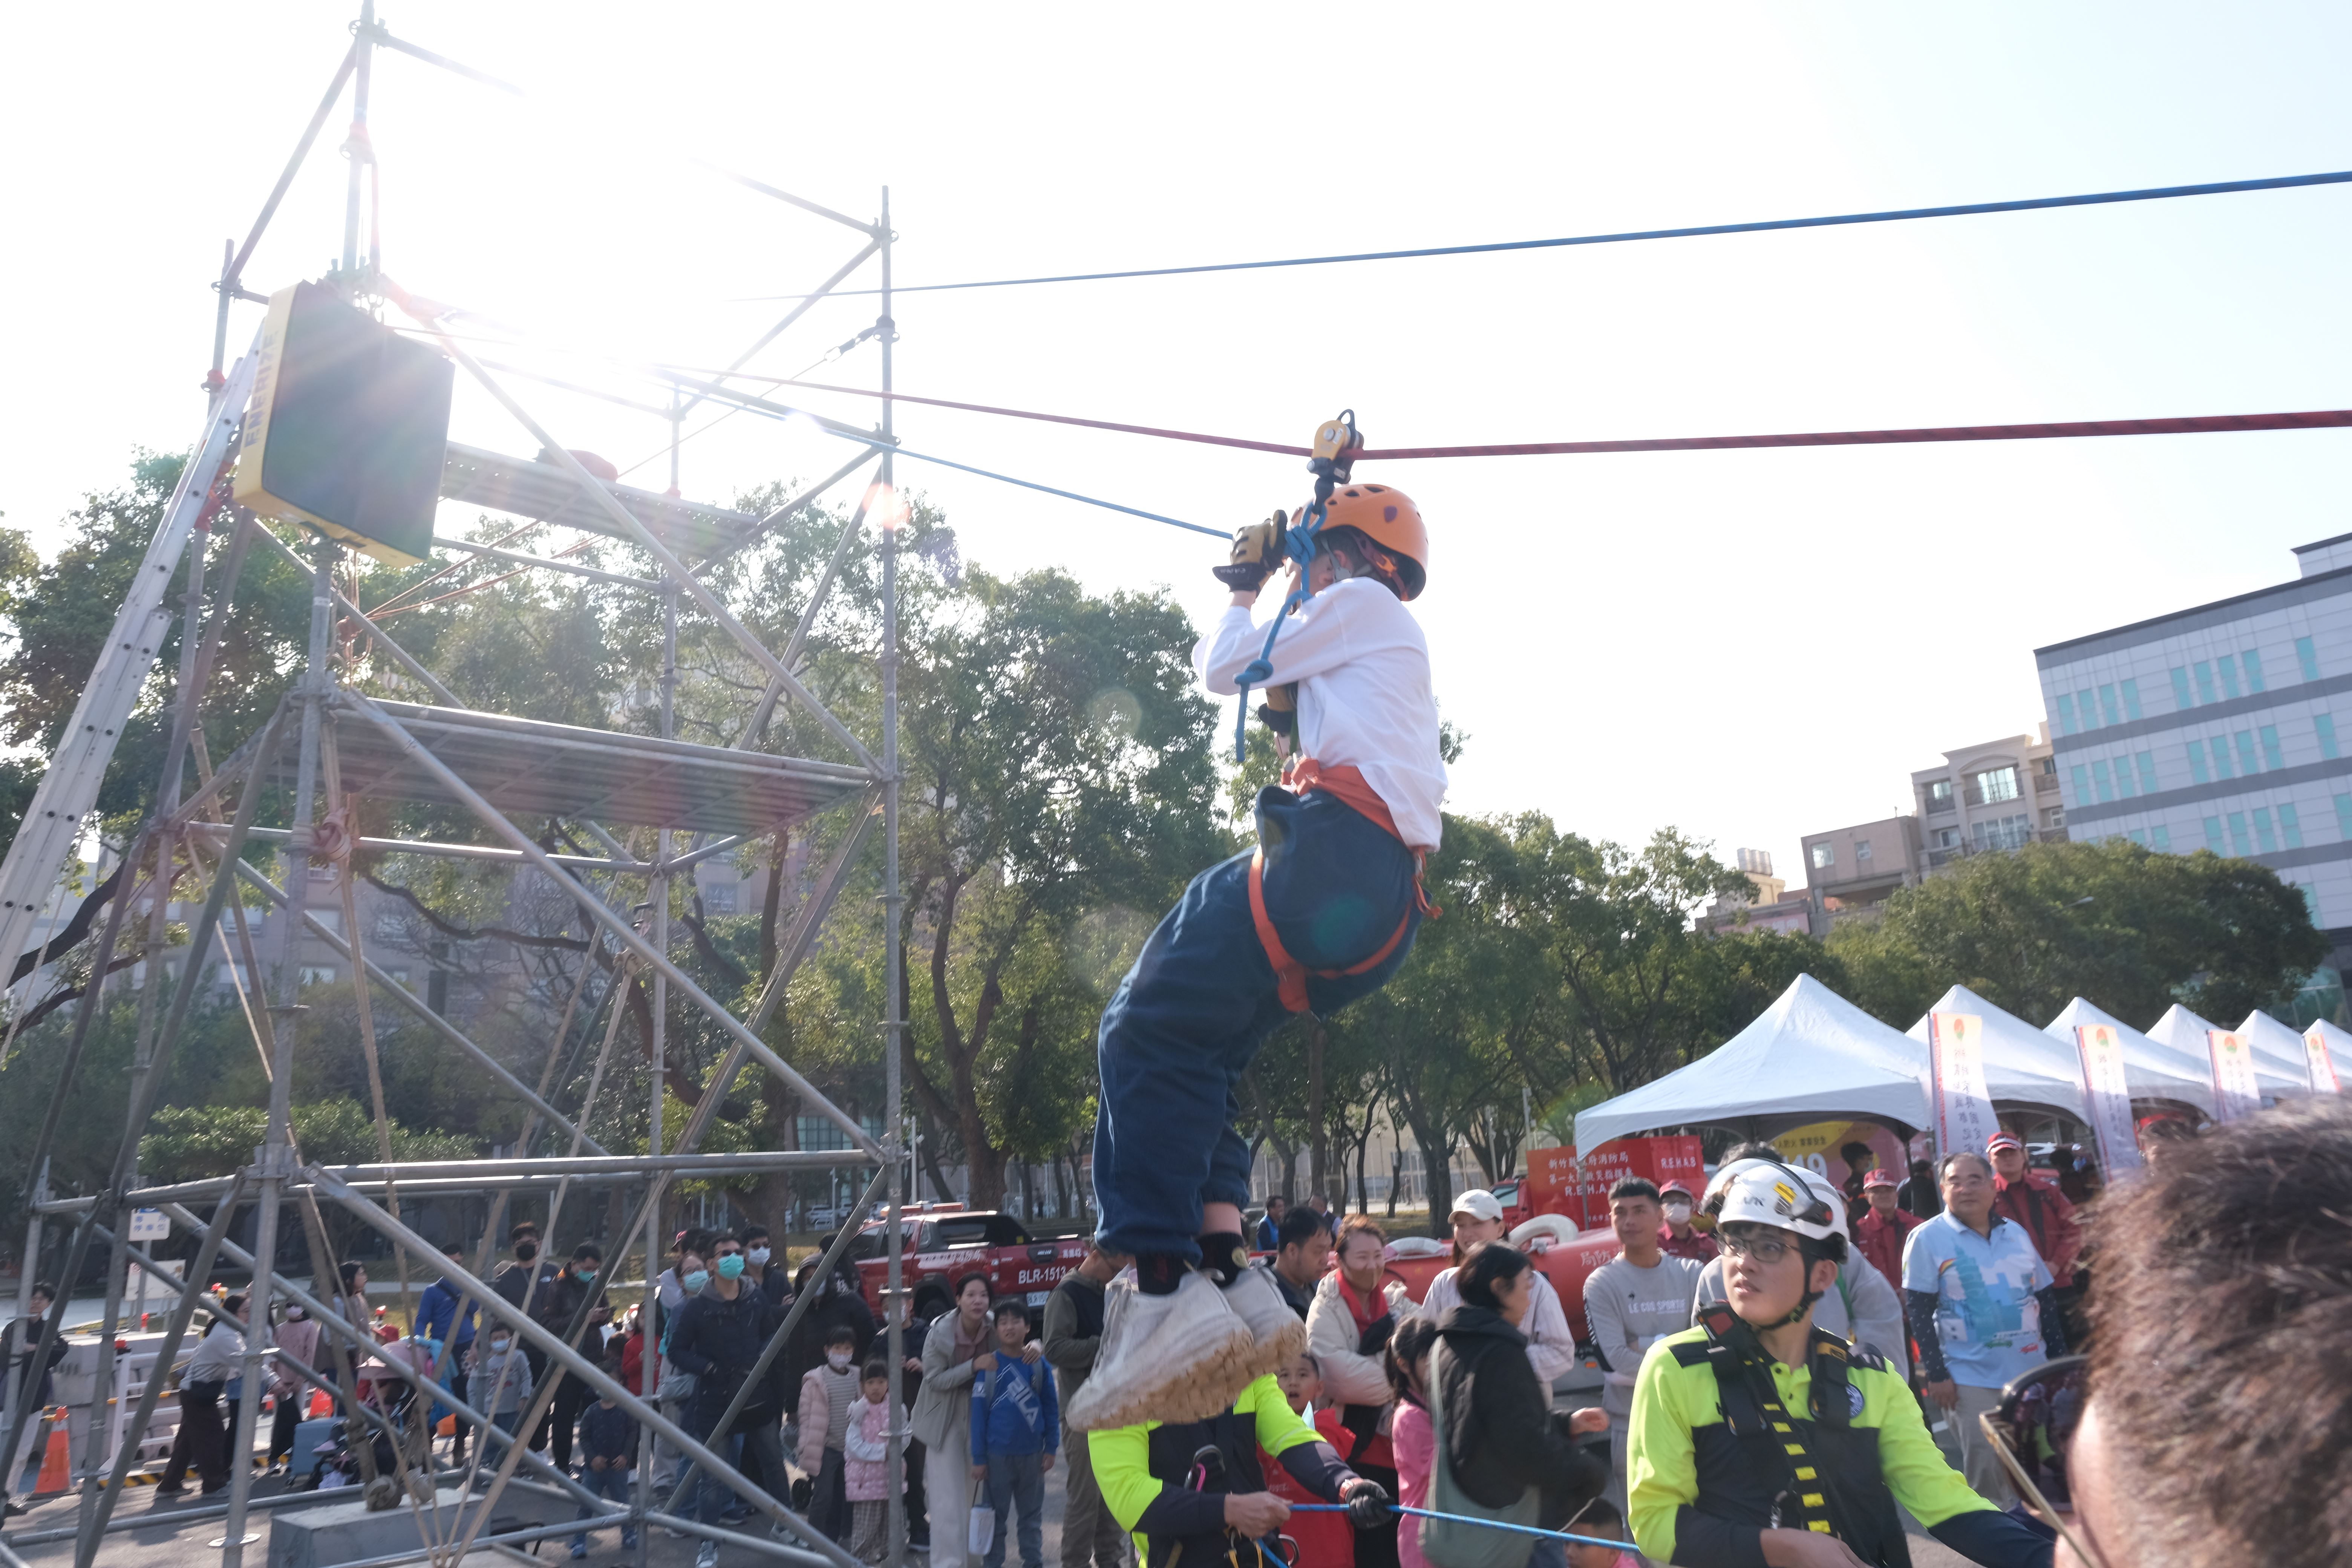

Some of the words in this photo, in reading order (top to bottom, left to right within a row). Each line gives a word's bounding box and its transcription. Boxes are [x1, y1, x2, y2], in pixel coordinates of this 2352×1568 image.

[1548, 1151, 1628, 1170] 新竹縣府消防局
[1018, 1265, 1066, 1285] BLR-1513
